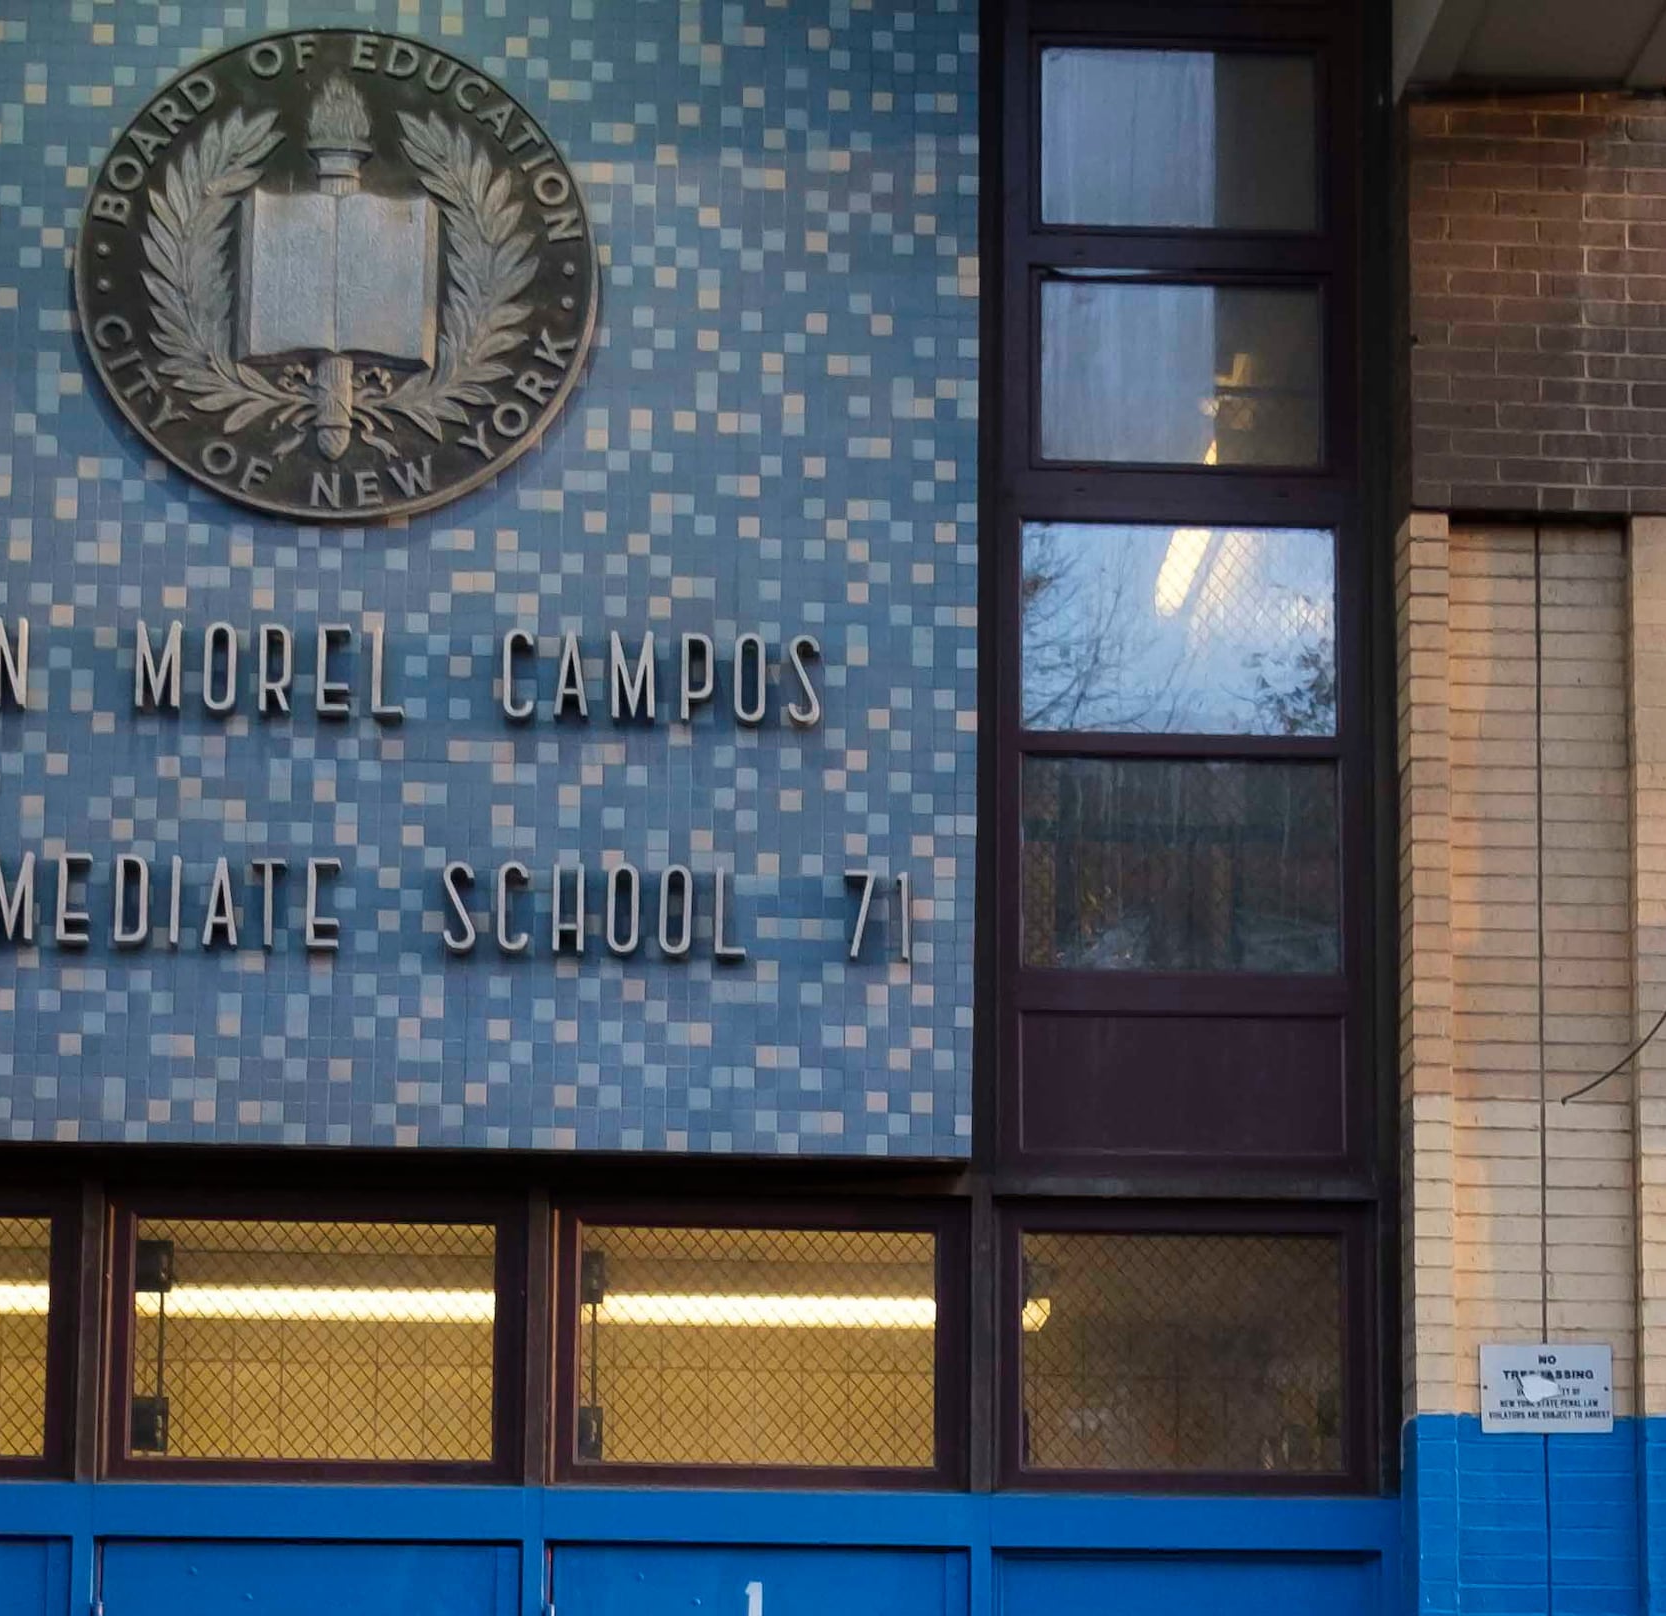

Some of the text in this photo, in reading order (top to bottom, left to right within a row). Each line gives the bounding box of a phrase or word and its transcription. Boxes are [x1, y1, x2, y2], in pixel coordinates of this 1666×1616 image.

[92, 36, 584, 244] BOARD OF EDUCATION
[94, 318, 578, 510] CITY OF NEW YORK
[134, 618, 404, 723] MOREL
[501, 627, 822, 728] CAMPOS
[441, 860, 747, 962] SCHOOL
[843, 868, 912, 964] 71
[1537, 1355, 1557, 1365] NO
